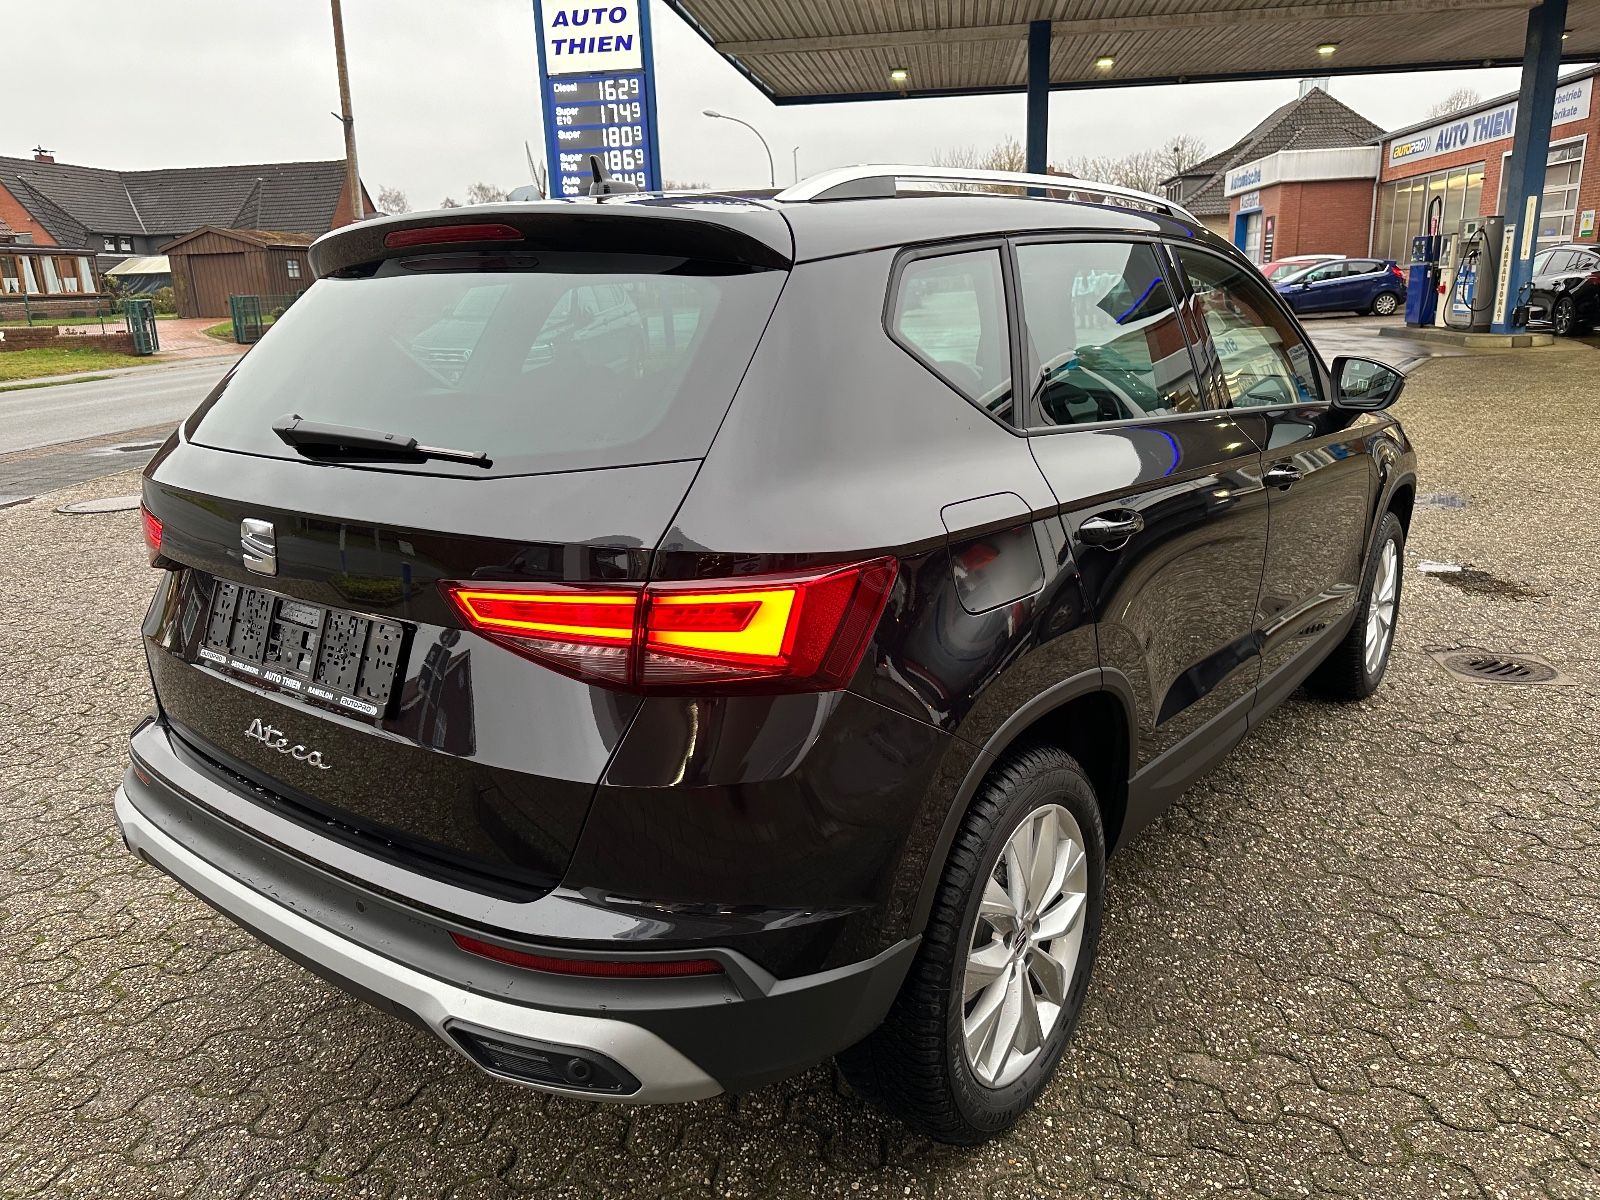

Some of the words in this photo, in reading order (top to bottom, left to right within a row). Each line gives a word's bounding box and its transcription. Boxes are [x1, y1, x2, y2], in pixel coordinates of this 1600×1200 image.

[552, 6, 627, 28] AUTO
[552, 34, 634, 56] THIEN
[553, 82, 578, 93] Diesel
[555, 106, 579, 116] Super
[556, 116, 573, 126] E10
[557, 130, 581, 140] Super
[1435, 122, 1469, 152] AUTO
[1473, 108, 1515, 142] THIEN
[559, 152, 583, 163] Super
[560, 163, 578, 172] Plus
[561, 176, 581, 186] Auto
[562, 185, 579, 195] Gas
[263, 670, 282, 684] AUTO
[281, 676, 302, 691] THIEN
[244, 718, 332, 770] Ateca
